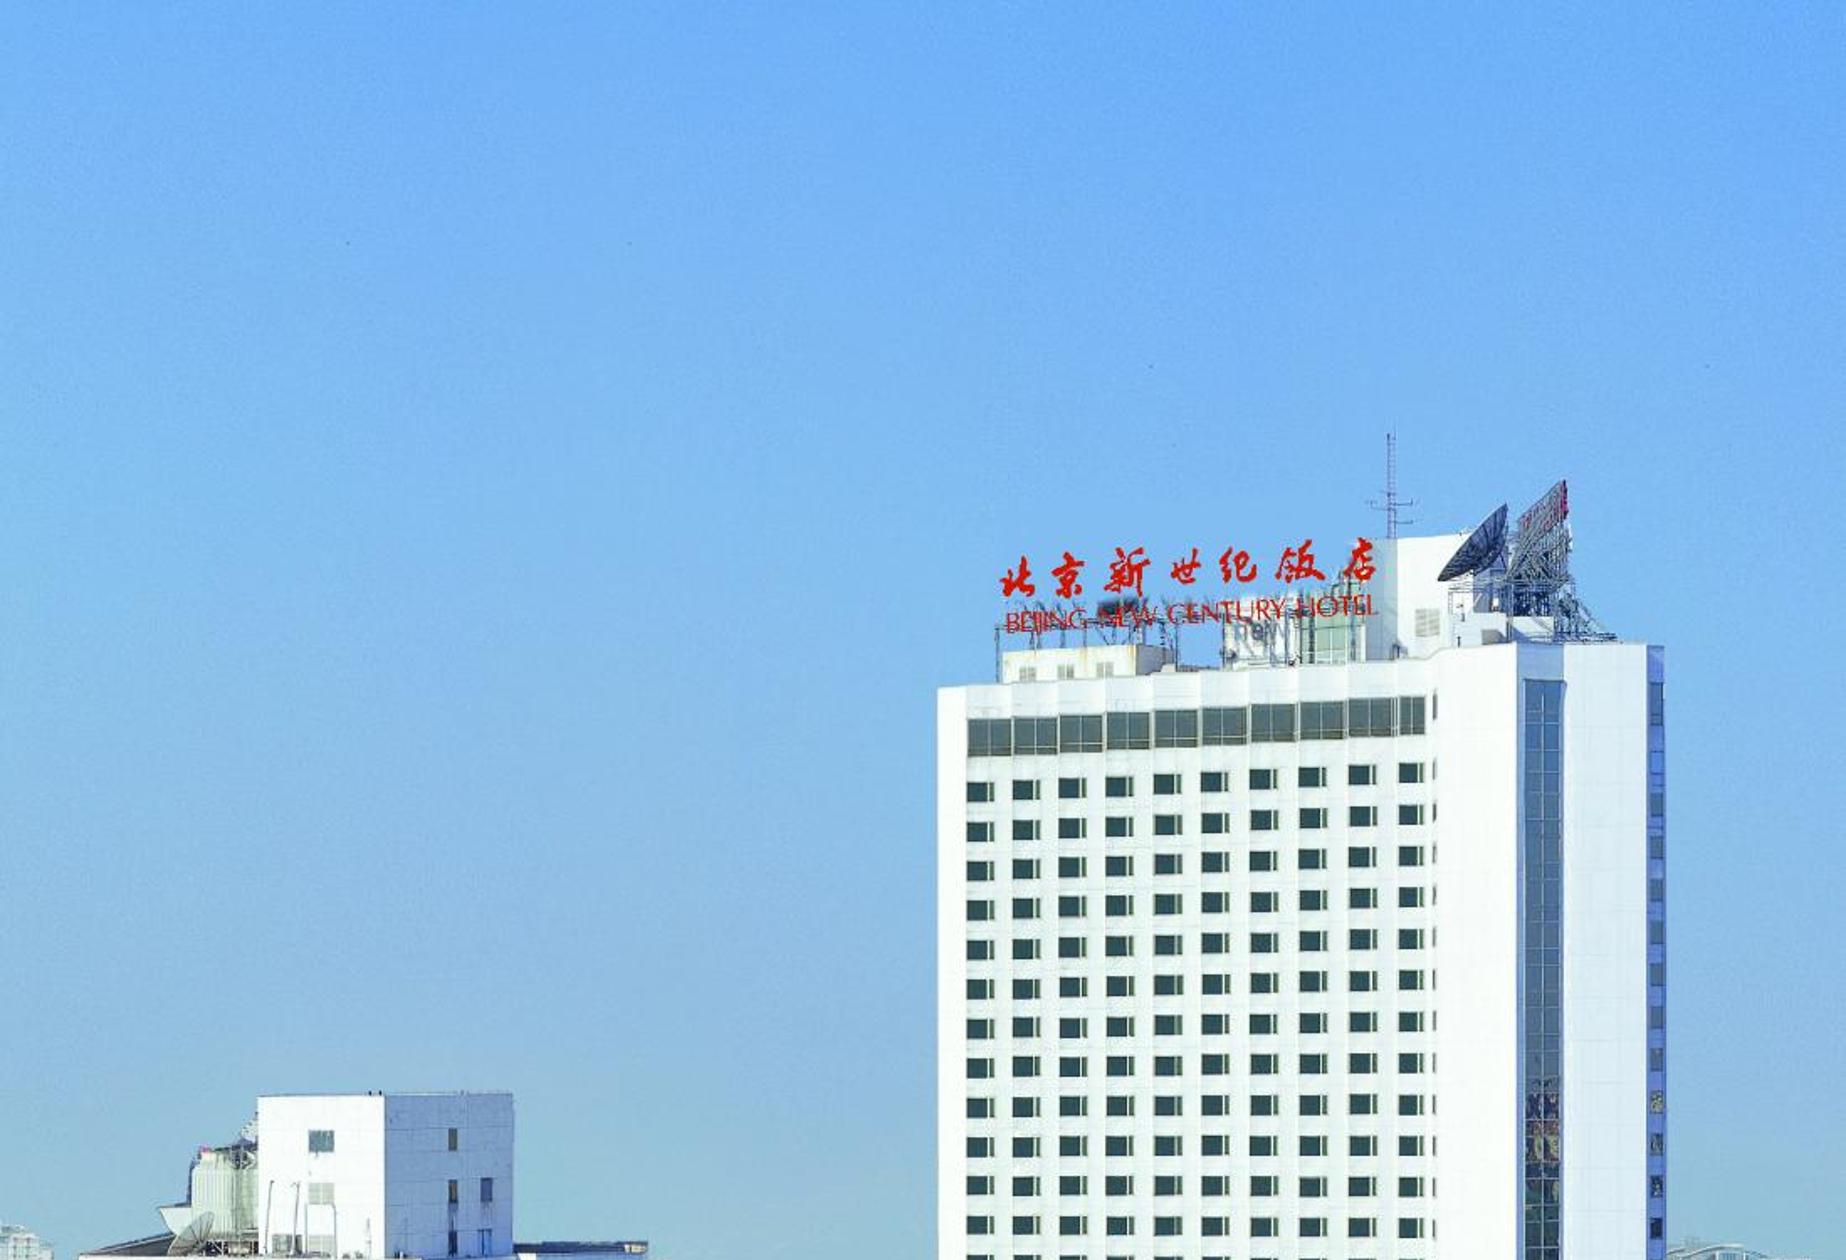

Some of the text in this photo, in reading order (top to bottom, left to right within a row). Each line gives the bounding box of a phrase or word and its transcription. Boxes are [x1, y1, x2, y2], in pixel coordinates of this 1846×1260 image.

[1005, 593, 1377, 634] BEIJING NEW CENTURY HOTEL
